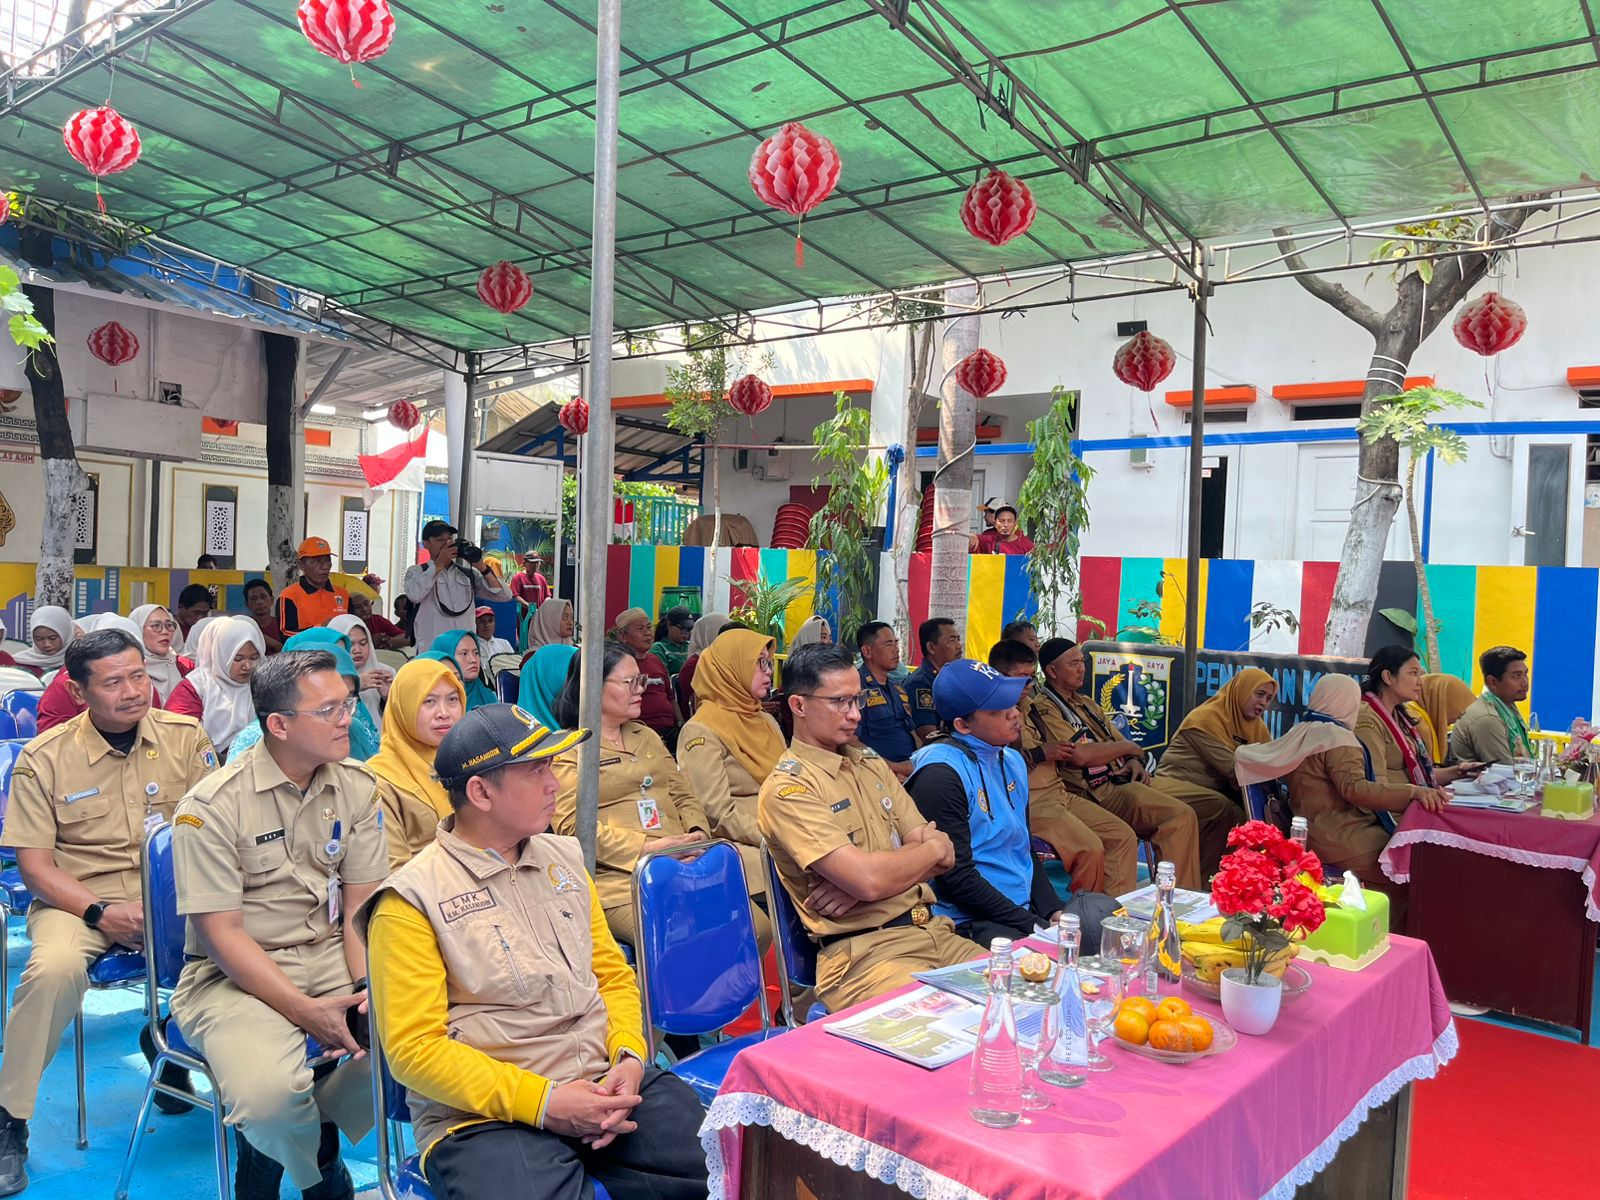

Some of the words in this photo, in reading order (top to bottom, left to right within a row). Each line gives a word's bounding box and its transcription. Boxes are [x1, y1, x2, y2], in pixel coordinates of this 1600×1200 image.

[1097, 657, 1116, 666] JAYA
[1146, 661, 1165, 670] RAYA
[1196, 660, 1296, 706] PENAN
